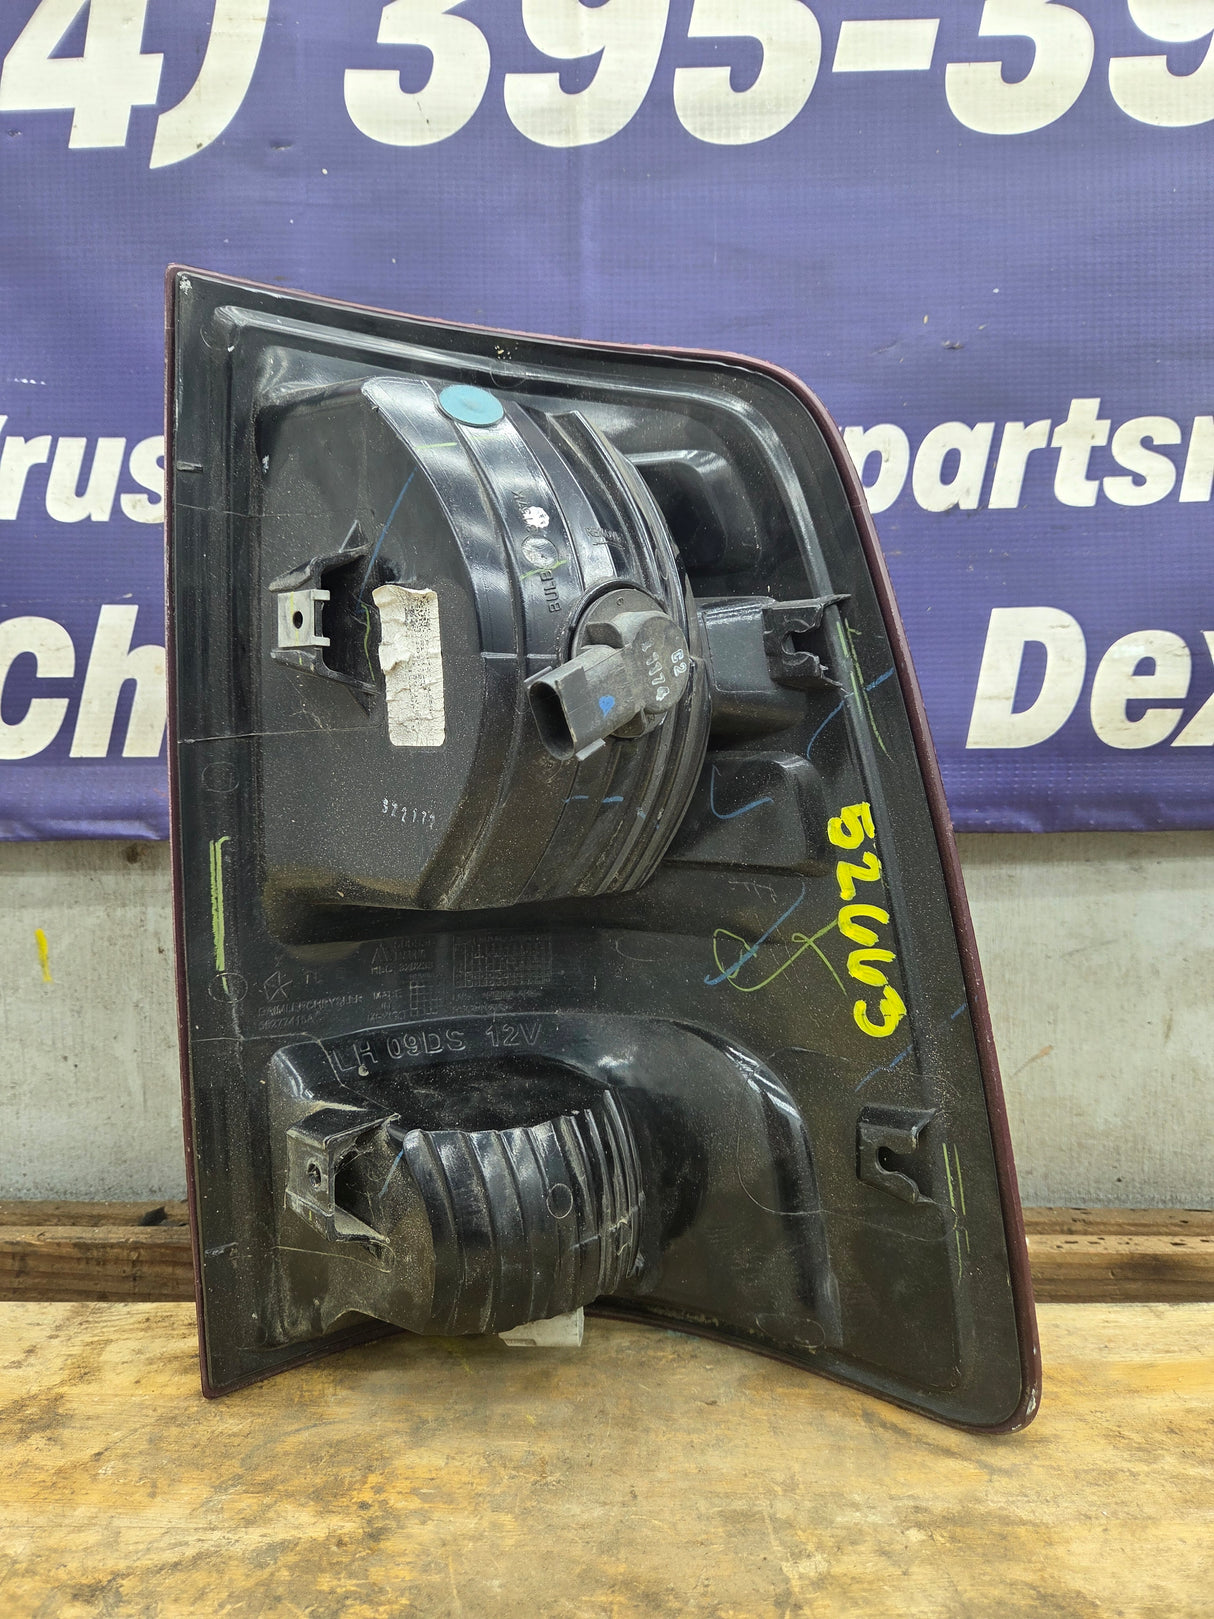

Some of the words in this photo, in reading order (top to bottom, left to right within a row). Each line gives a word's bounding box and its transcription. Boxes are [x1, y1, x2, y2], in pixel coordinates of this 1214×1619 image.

[539, 568, 562, 613] BULB
[333, 1041, 378, 1072] LH
[484, 1022, 541, 1048] 12V
